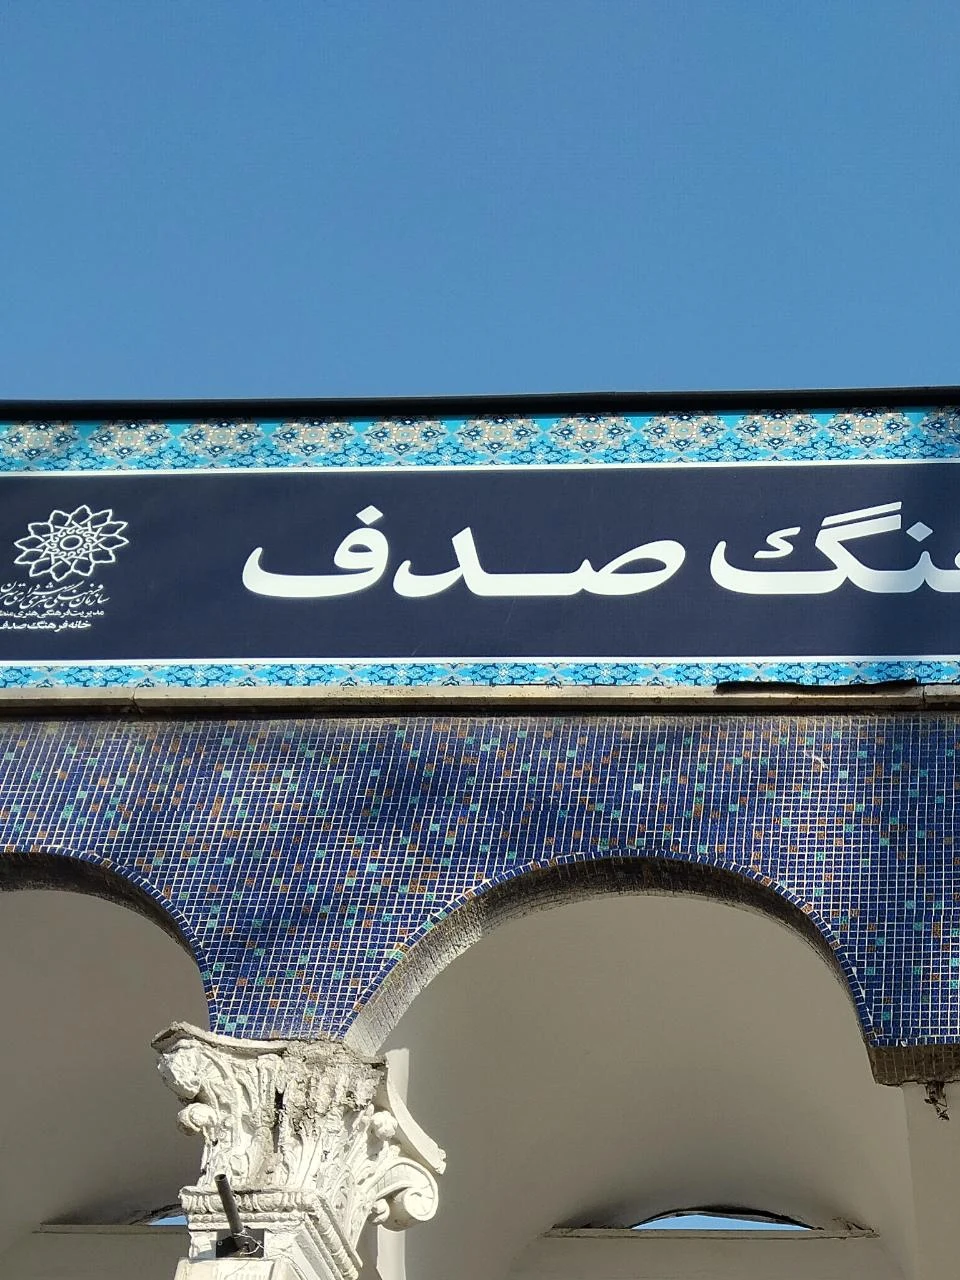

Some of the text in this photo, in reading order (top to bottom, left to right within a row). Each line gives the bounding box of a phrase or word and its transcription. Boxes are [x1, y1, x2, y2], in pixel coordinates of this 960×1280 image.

[241, 504, 687, 599] صدف
[27, 620, 68, 633] فرهنگ
[68, 620, 92, 630] خانه
